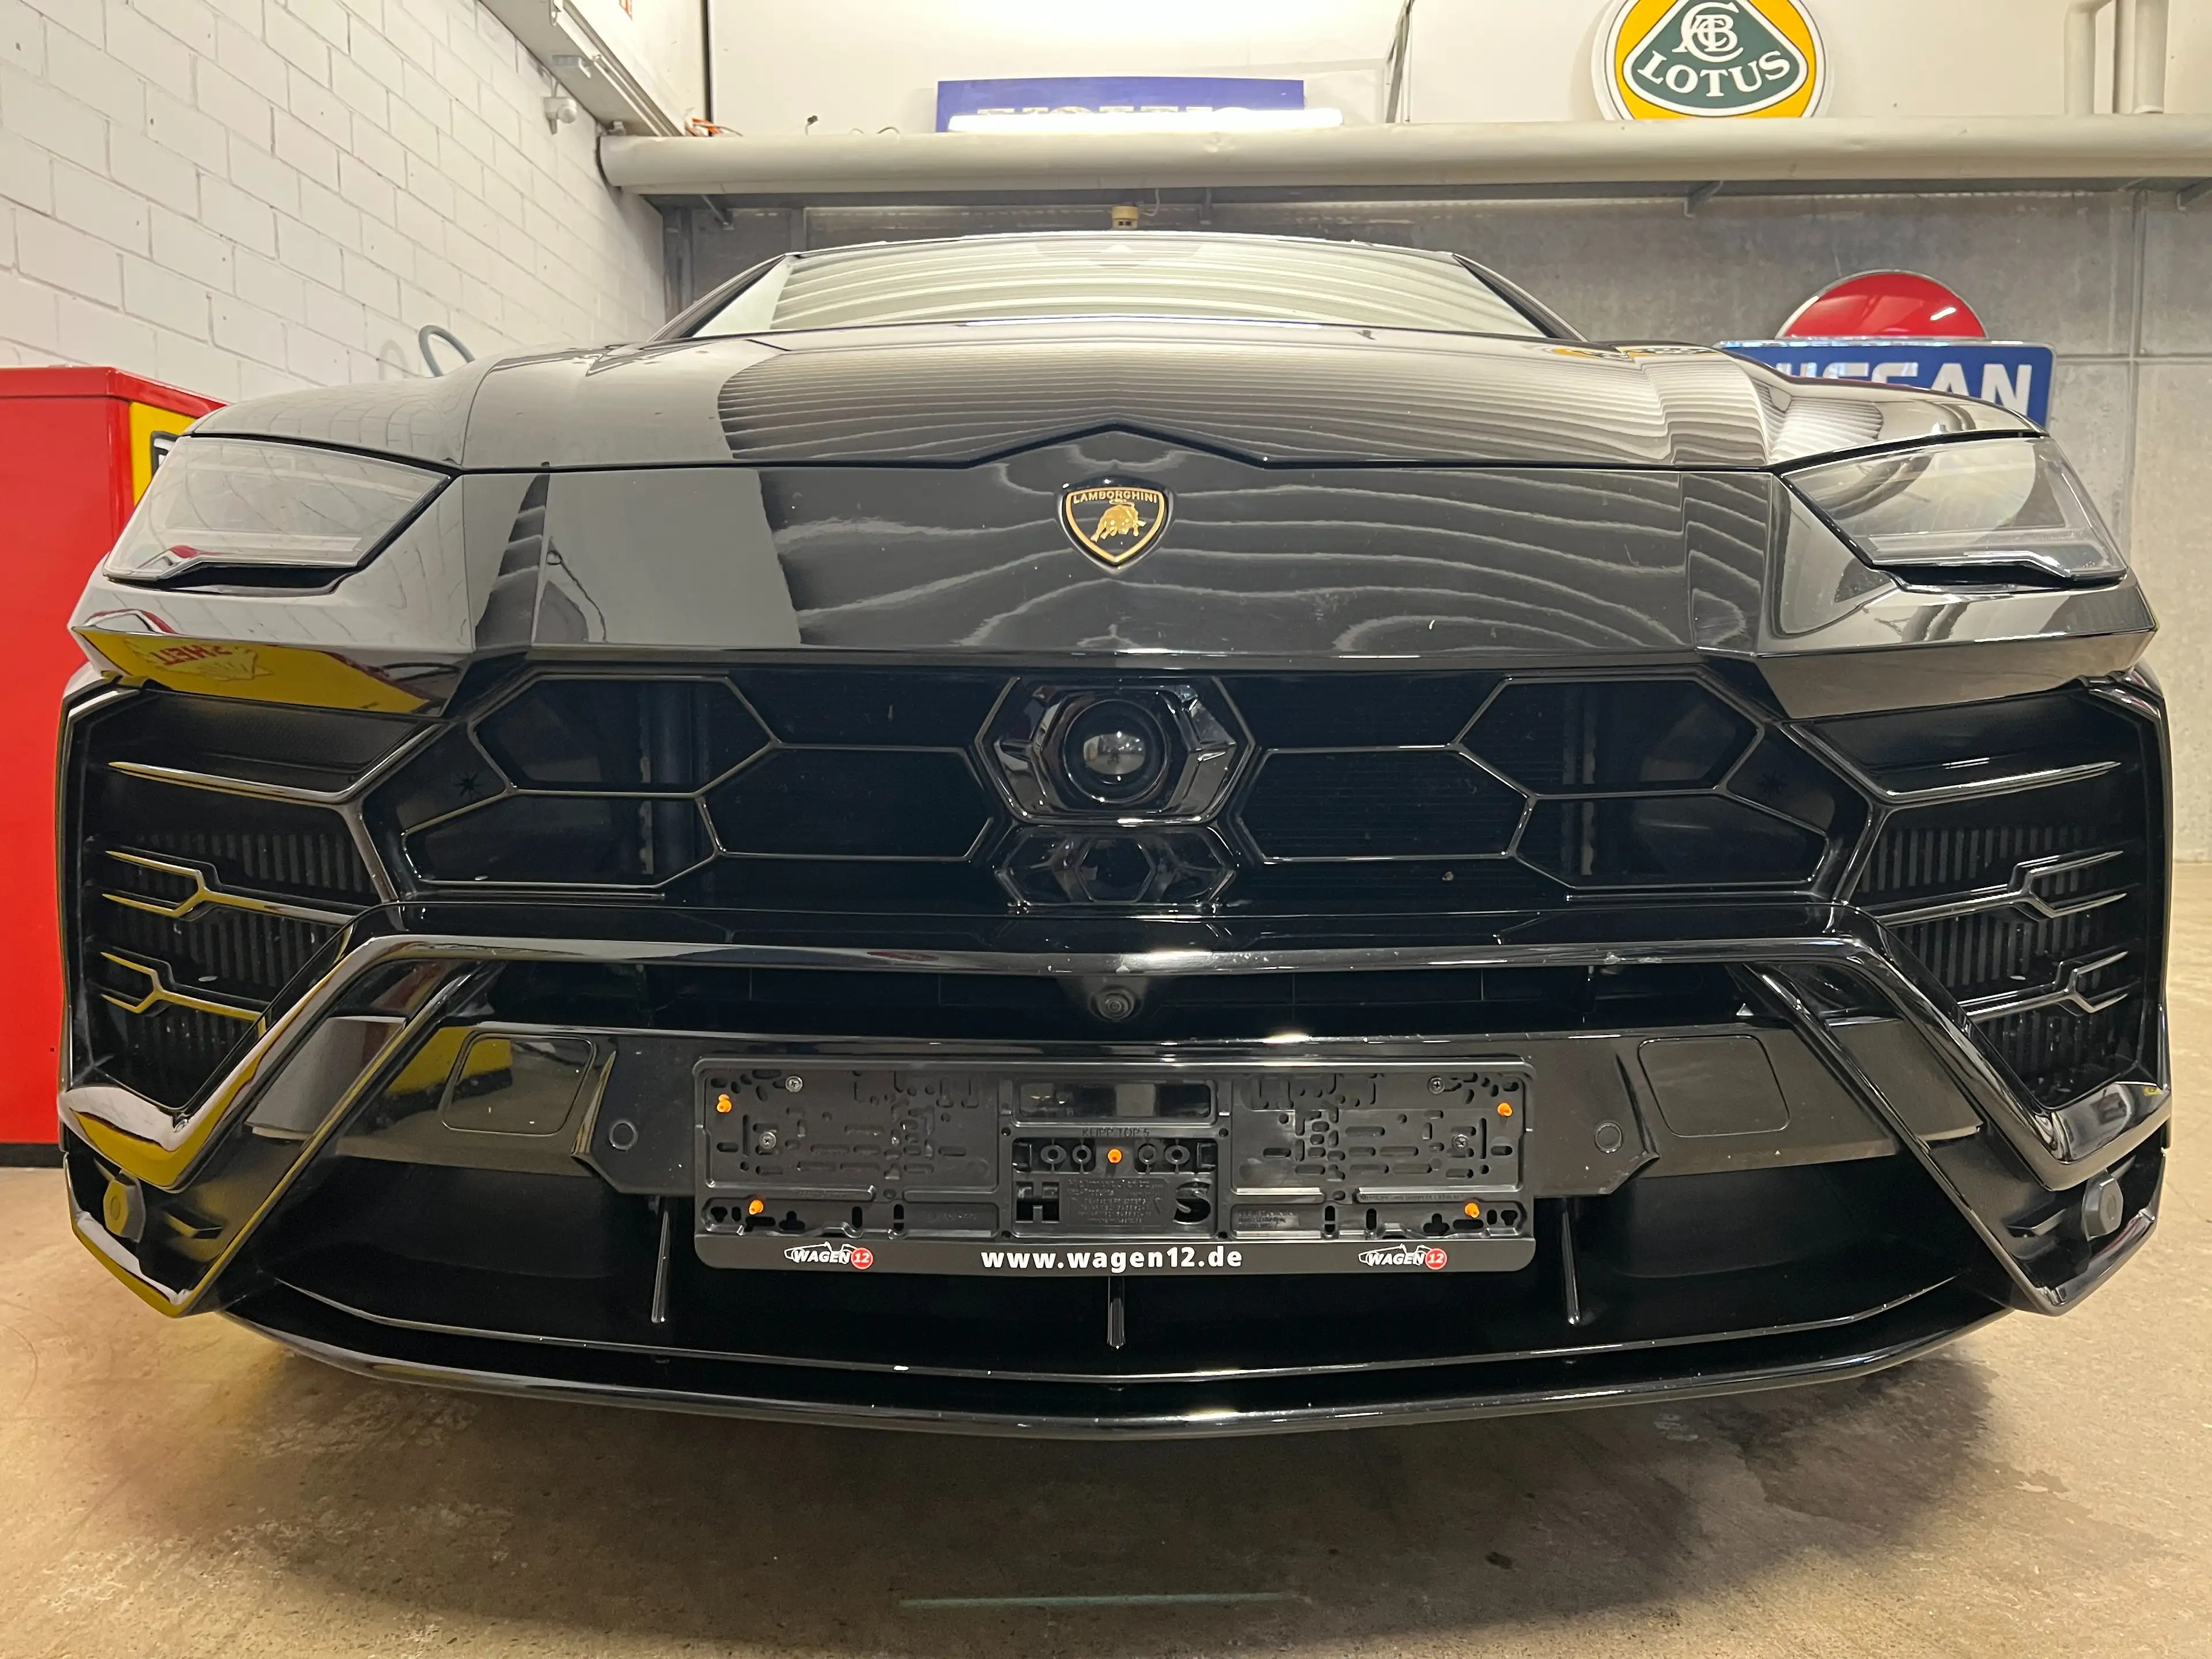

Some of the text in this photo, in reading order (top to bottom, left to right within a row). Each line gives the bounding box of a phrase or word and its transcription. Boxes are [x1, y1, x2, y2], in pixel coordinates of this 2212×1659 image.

[1637, 50, 1791, 97] LOTUS
[1073, 490, 1157, 504] LAMBORGHINI
[1116, 1127, 1140, 1137] TOP
[980, 1245, 1243, 1274] www.wagen12.de
